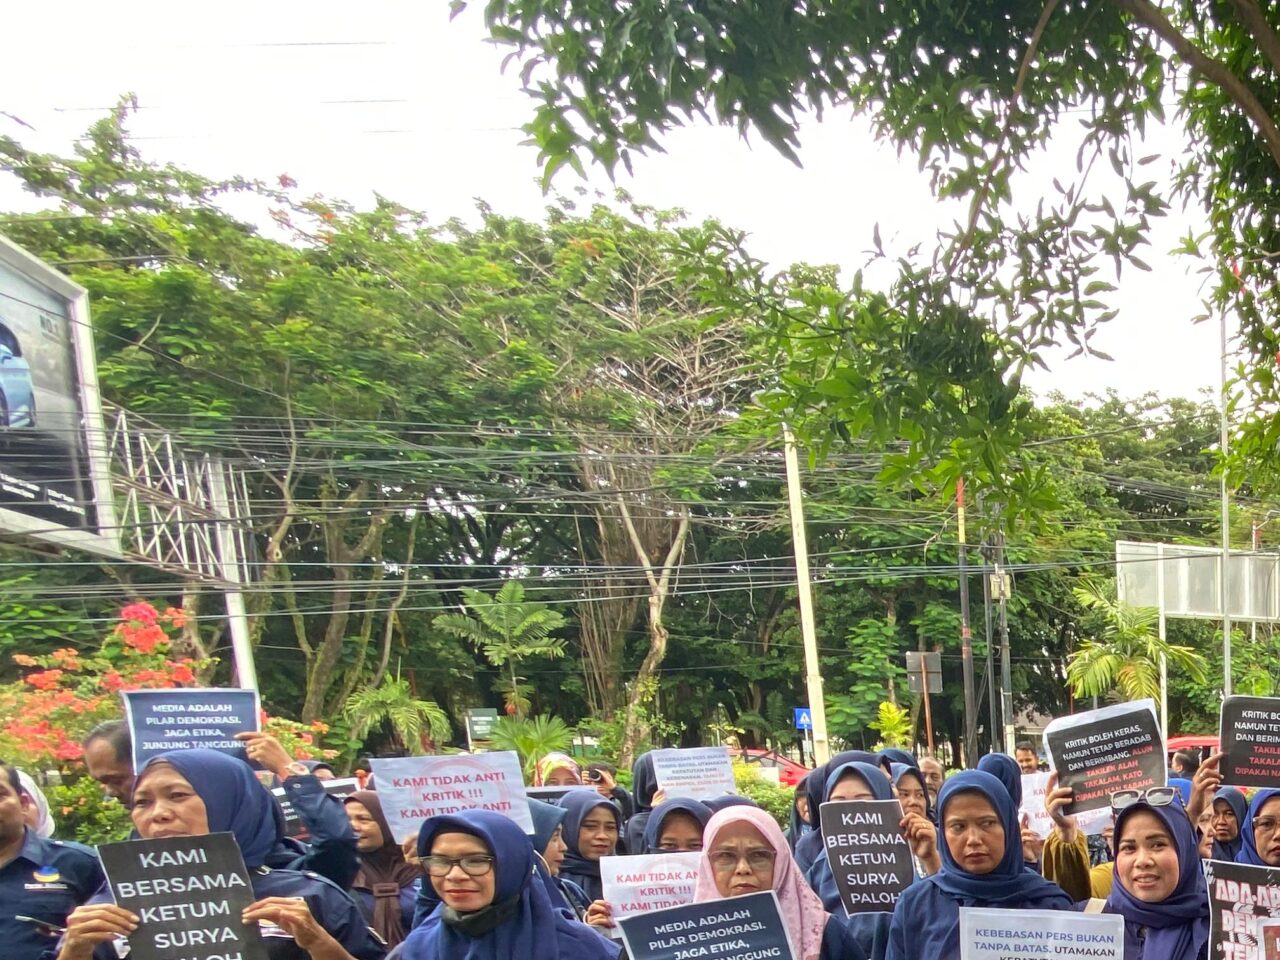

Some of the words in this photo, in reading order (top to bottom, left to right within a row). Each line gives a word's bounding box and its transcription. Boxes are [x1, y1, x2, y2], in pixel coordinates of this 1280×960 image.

[1242, 711, 1268, 719] KRITIK
[1235, 722, 1266, 730] NAMUN
[1065, 738, 1088, 749] KRITIK
[1089, 732, 1113, 743] BOLEH
[1236, 733, 1254, 741] DAN
[1063, 749, 1090, 761] NAMUN
[1091, 745, 1113, 755] TETAP
[1115, 734, 1151, 749] BERADAB
[1068, 761, 1084, 771] DAN
[1133, 746, 1153, 756] ALUN
[1118, 760, 1138, 770] ALAH
[1123, 771, 1143, 780] KATO
[1235, 768, 1269, 776] DIPAKAI
[393, 778, 428, 787] KAMI
[430, 775, 471, 786] TIDAK
[475, 772, 505, 782] ANTI
[422, 790, 465, 801] KRITIK
[401, 806, 434, 818] KAMI
[841, 812, 882, 825] KAMI
[827, 833, 906, 847] BERSAMA
[139, 848, 208, 868] KAMI
[839, 853, 896, 866] KETUM
[617, 874, 645, 883] KAMI
[648, 872, 681, 881] TIDAK
[847, 873, 900, 885] SURYA
[117, 873, 247, 897] BERSAMA
[640, 887, 676, 896] KRITIK
[140, 901, 230, 923] KETUM
[621, 903, 650, 911] KAMI
[654, 920, 696, 935] MEDIA
[700, 910, 750, 927] ADALAH
[155, 927, 238, 948] SURYA
[649, 937, 686, 951] PILAR
[689, 921, 766, 942] DEMOKRASI.
[975, 929, 1042, 939] KEBEBASAN
[1046, 932, 1073, 941] PERS
[1077, 934, 1114, 943] BUKAN
[674, 948, 708, 960] JAGA
[711, 939, 750, 954] ETIKA,
[974, 942, 1010, 951] TANPA
[1014, 944, 1052, 953] BATAS.
[1054, 947, 1115, 956] UTAMAKAN
